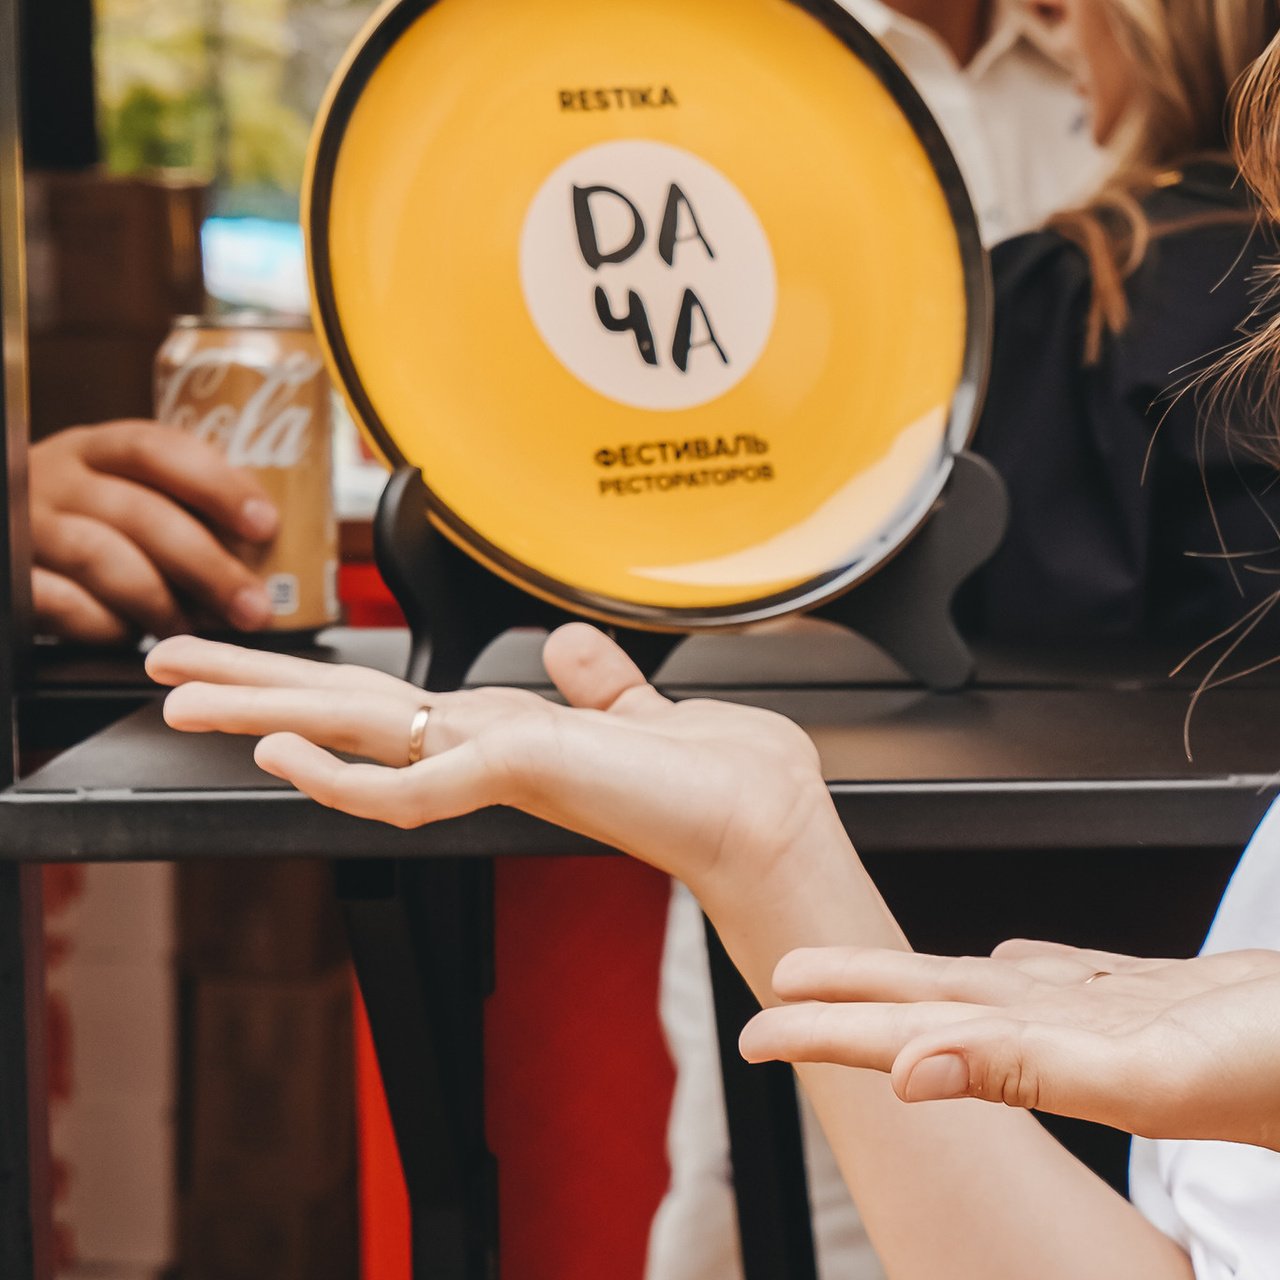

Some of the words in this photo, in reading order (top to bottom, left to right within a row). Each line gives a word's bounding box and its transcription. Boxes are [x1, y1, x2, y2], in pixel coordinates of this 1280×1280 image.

[558, 86, 679, 112] RESTIKA
[594, 433, 771, 470] ФЕСТИВАЛЬ
[598, 462, 776, 498] РЕСТОРАТОРОВ
